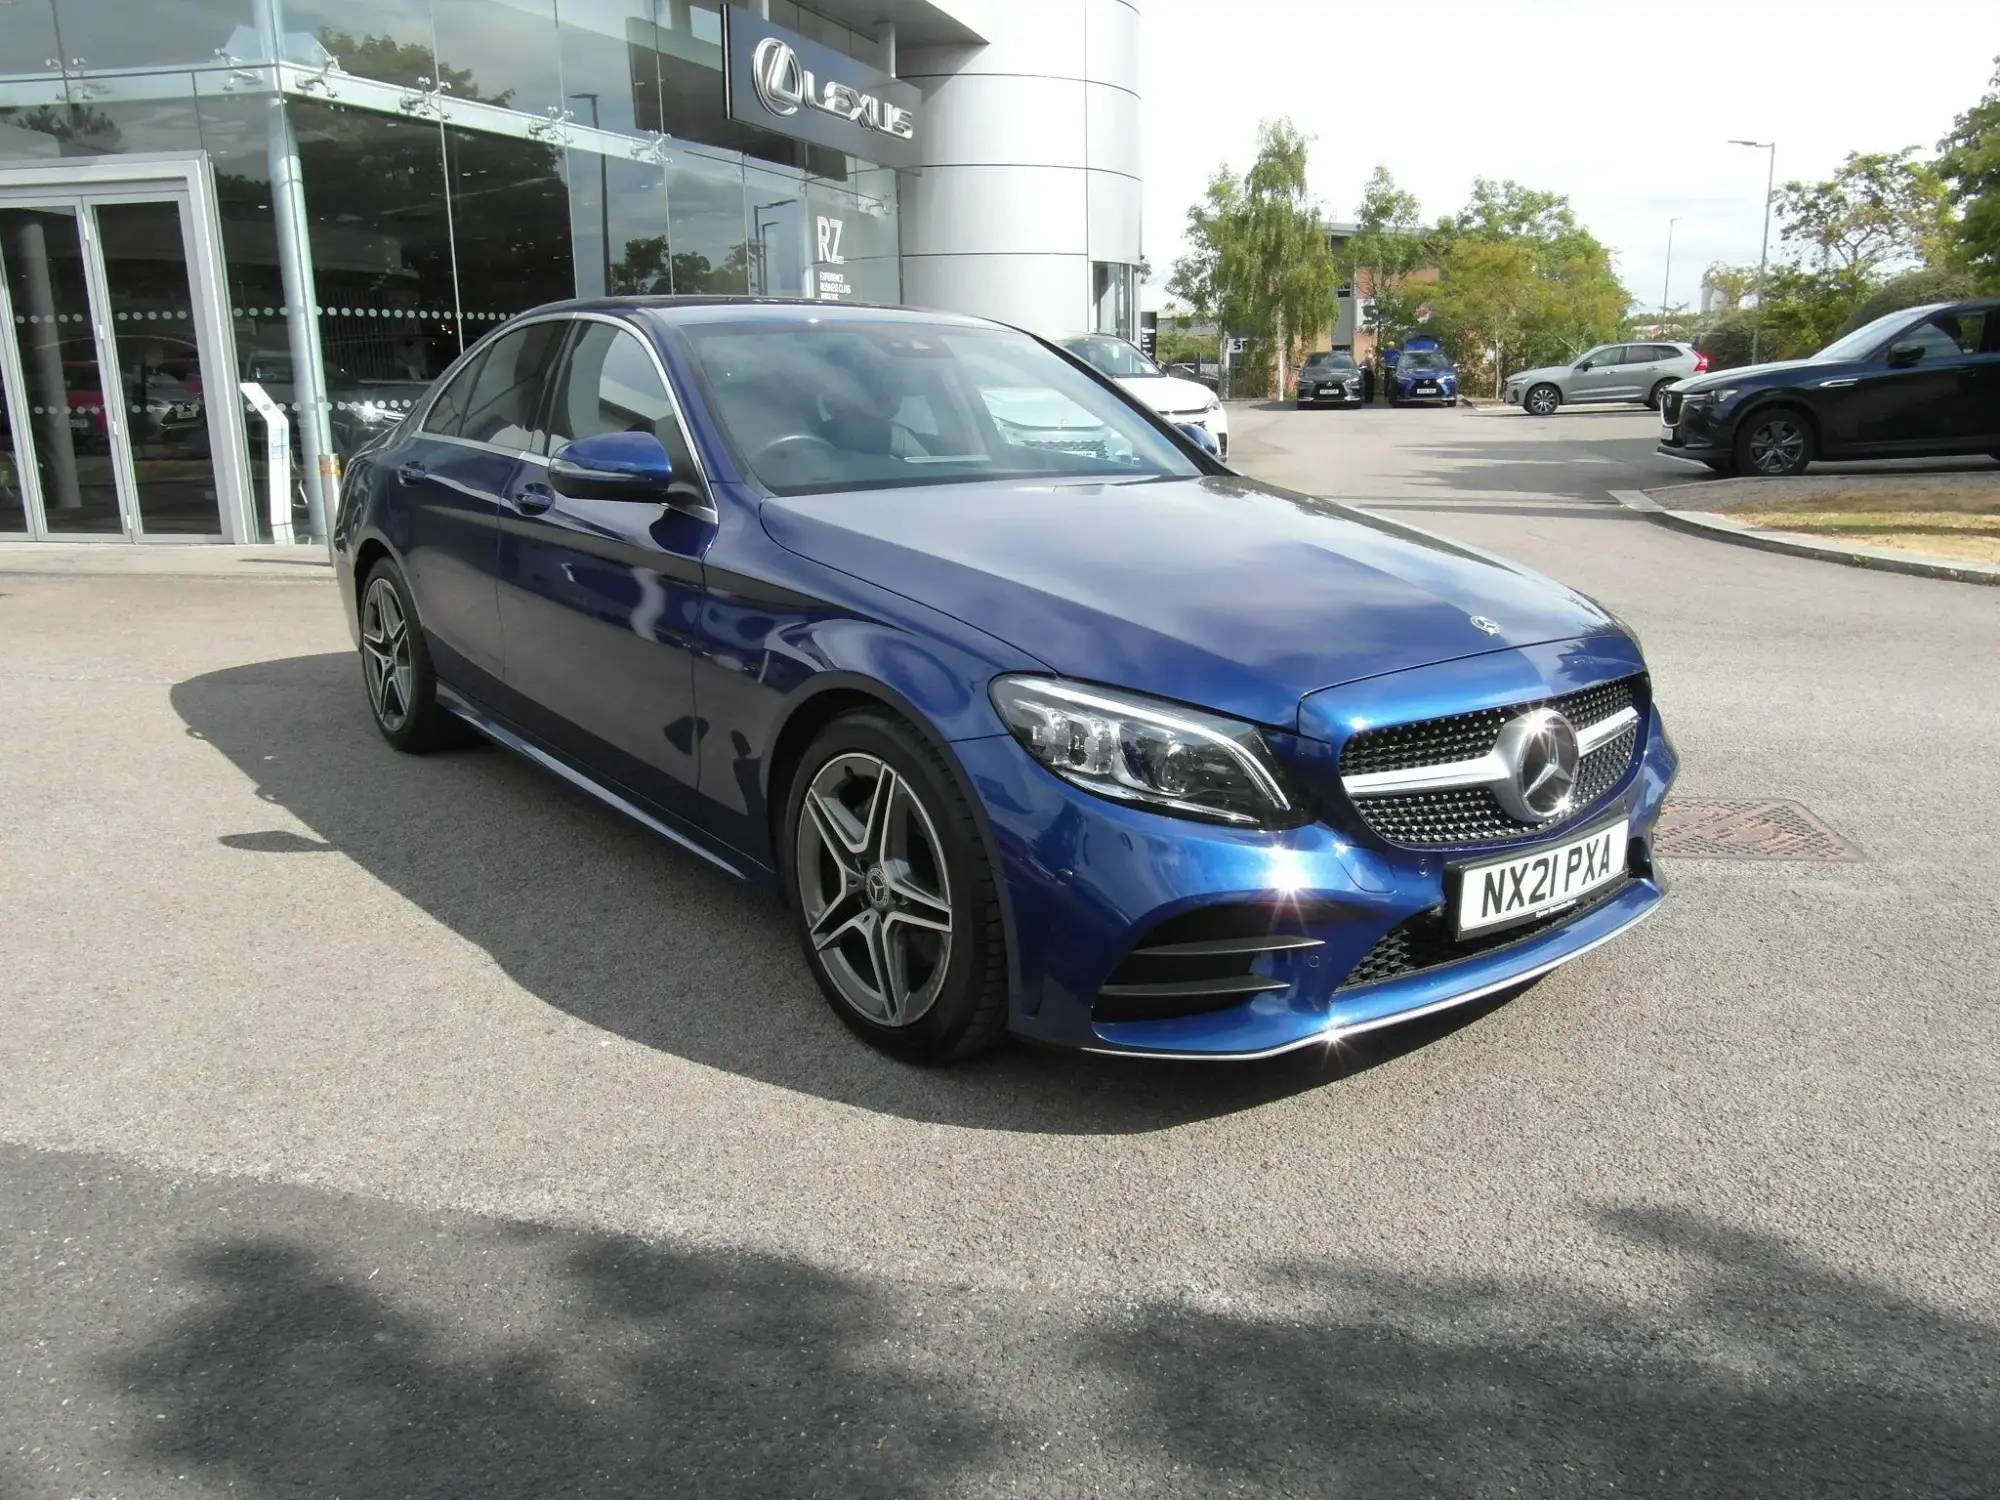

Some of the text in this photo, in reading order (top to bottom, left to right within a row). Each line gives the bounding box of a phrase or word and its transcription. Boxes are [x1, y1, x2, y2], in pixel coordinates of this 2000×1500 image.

[803, 70, 914, 141] LEXUS
[817, 216, 844, 264] RZ
[1481, 833, 1610, 918] NX21 PXA
